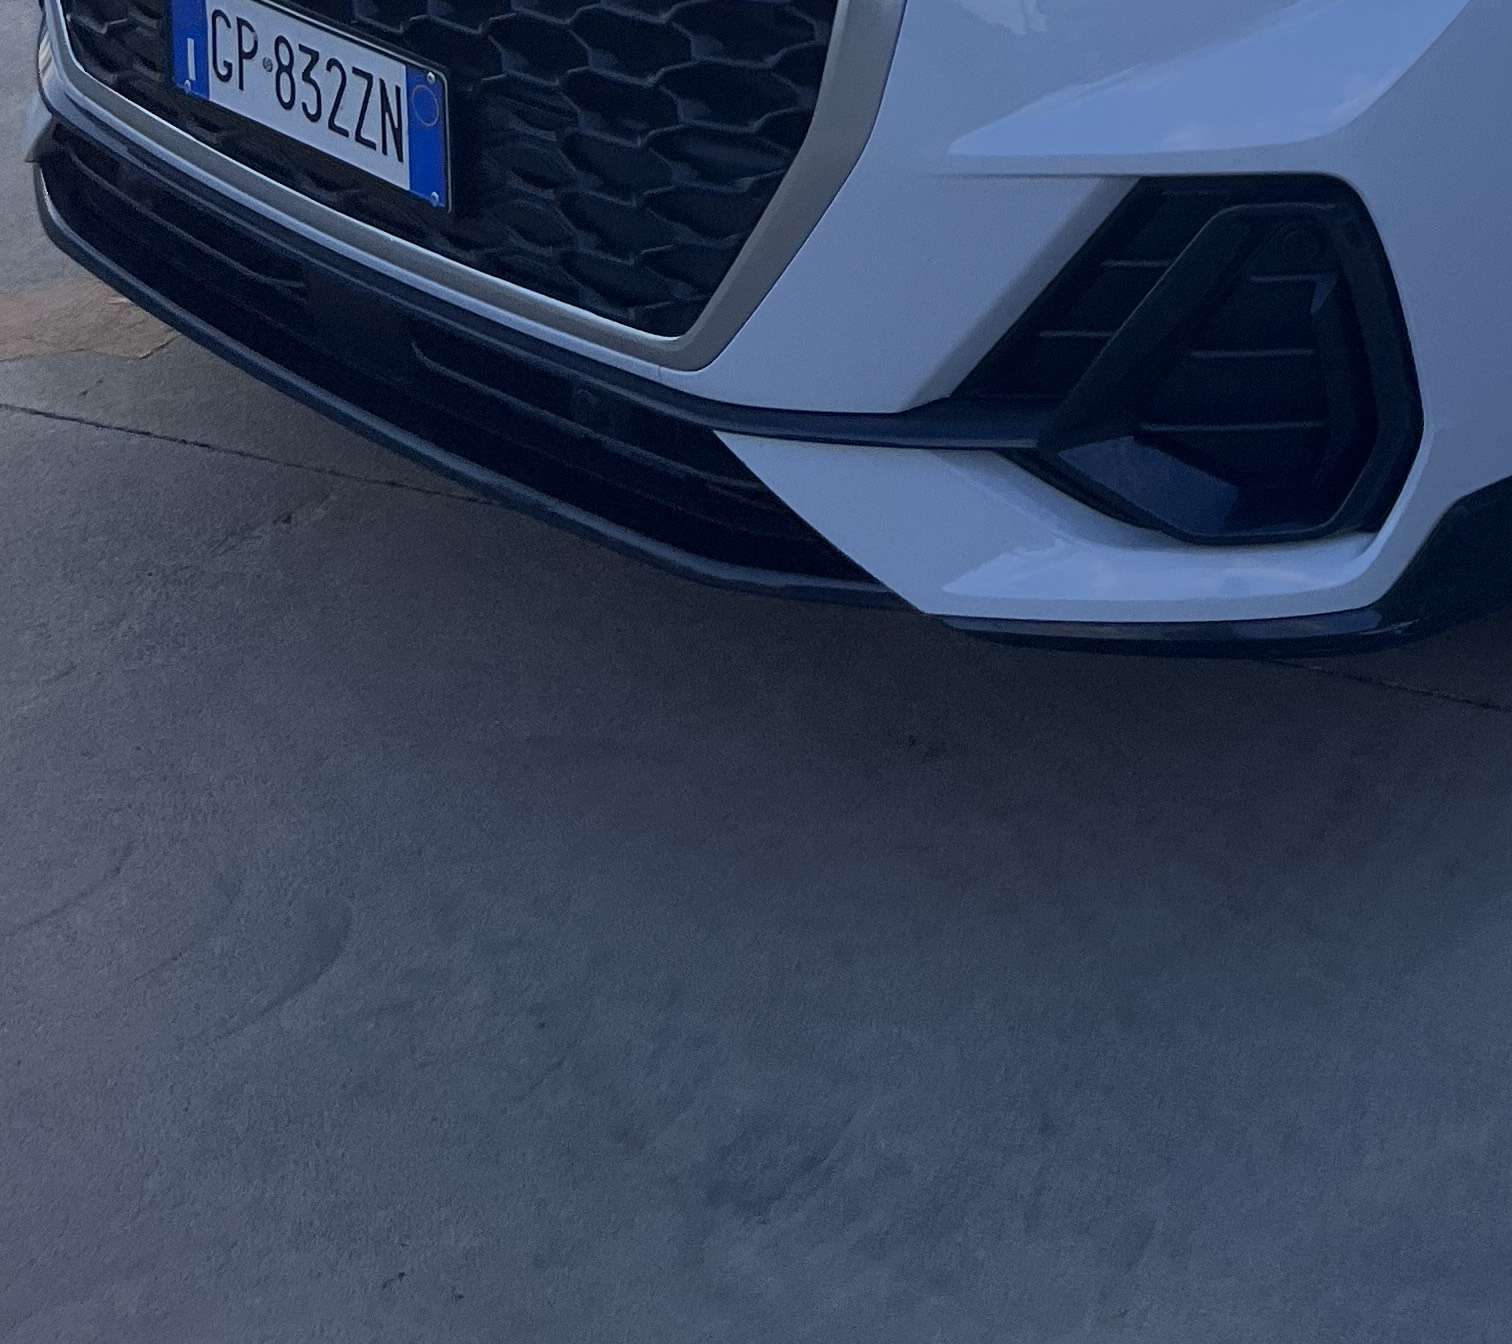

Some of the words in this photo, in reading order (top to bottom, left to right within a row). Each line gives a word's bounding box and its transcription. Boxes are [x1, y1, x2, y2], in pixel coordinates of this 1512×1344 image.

[187, 38, 196, 81] I
[211, 9, 258, 91] GP
[273, 35, 404, 163] 832ZN
